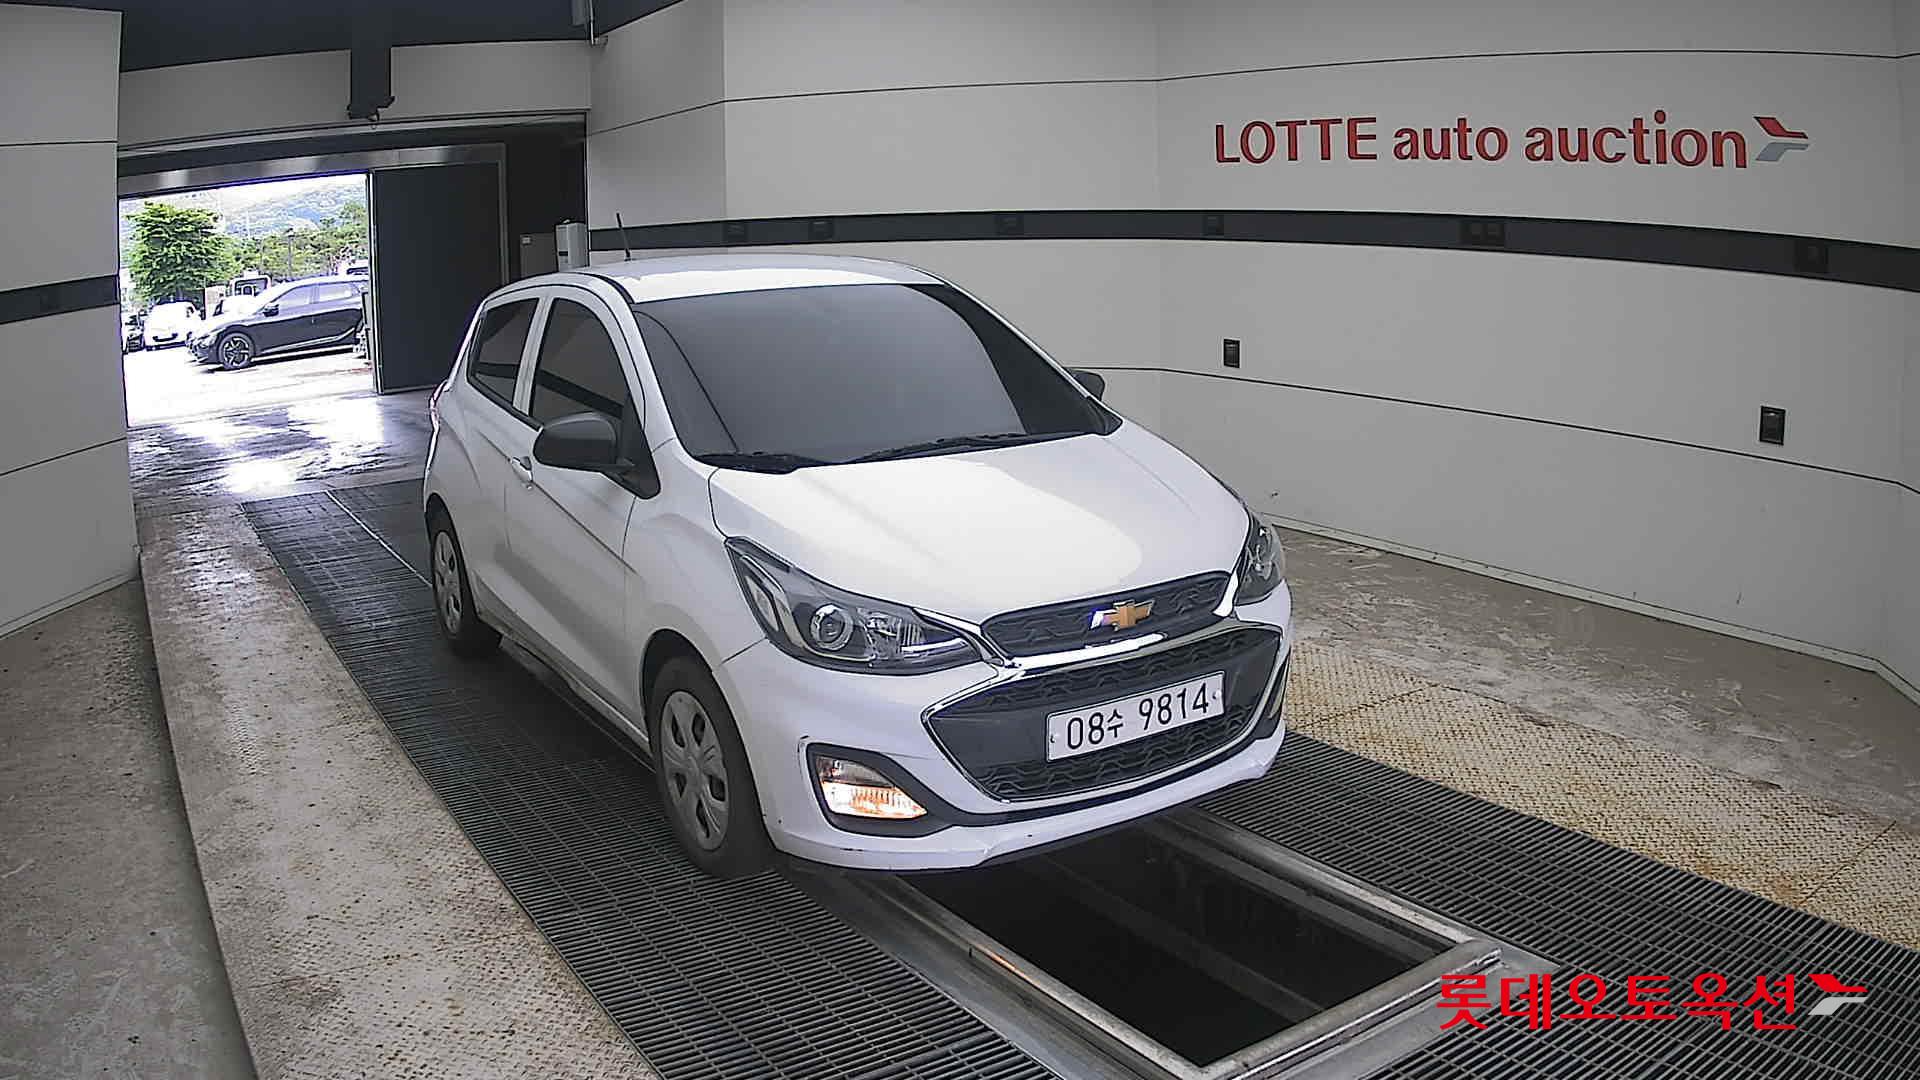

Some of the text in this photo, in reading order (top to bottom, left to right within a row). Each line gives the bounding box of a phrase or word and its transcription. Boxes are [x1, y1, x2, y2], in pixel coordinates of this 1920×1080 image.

[1214, 109, 1748, 169] LOTTE auto auction
[1067, 682, 1209, 750] 08수 9814
